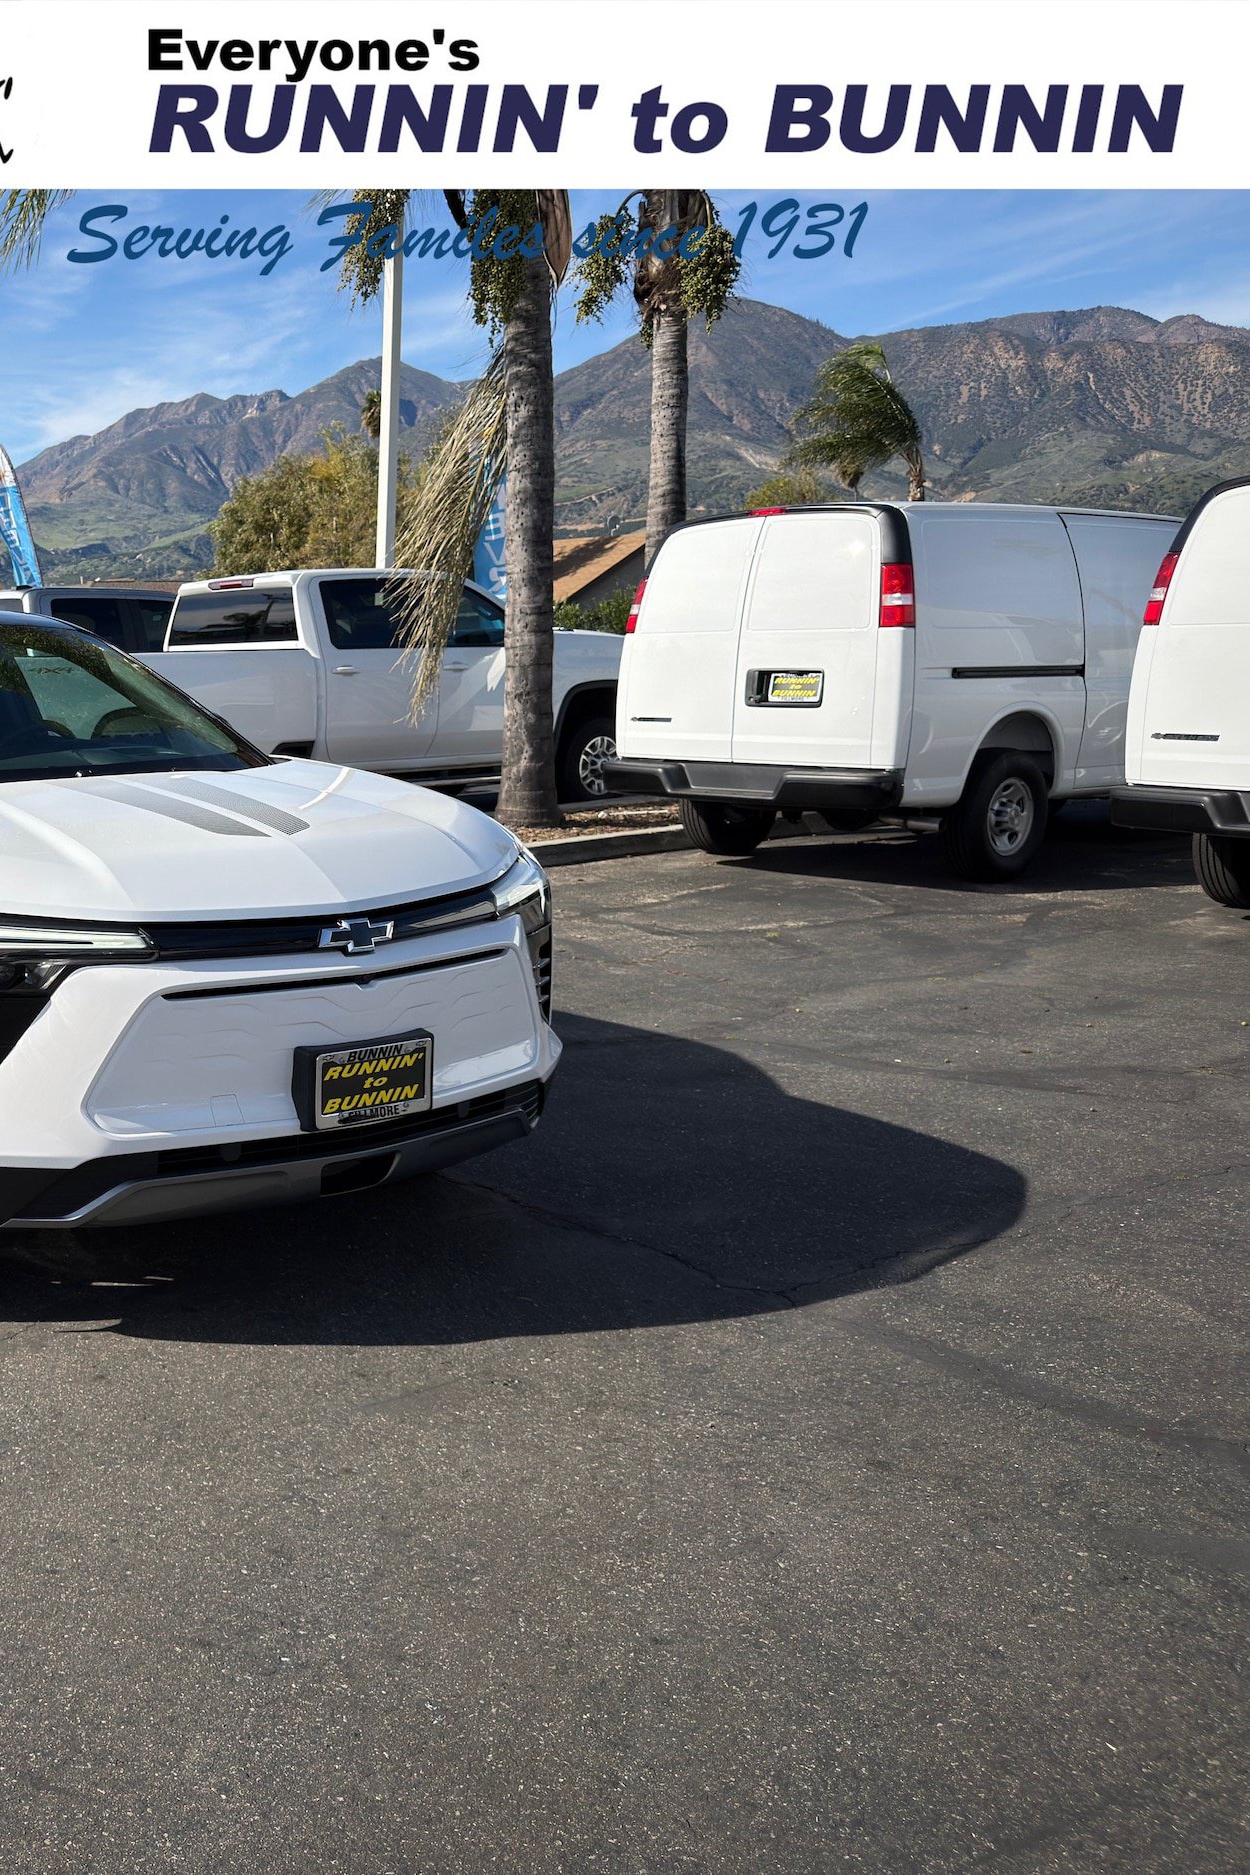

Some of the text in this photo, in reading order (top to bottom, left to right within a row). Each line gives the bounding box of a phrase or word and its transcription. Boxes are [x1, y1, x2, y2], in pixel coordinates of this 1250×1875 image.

[347, 1043, 404, 1064] BUNNIN
[323, 1052, 424, 1081] RUNNIN'
[363, 1076, 388, 1089] to
[323, 1084, 420, 1114] BUNNIN
